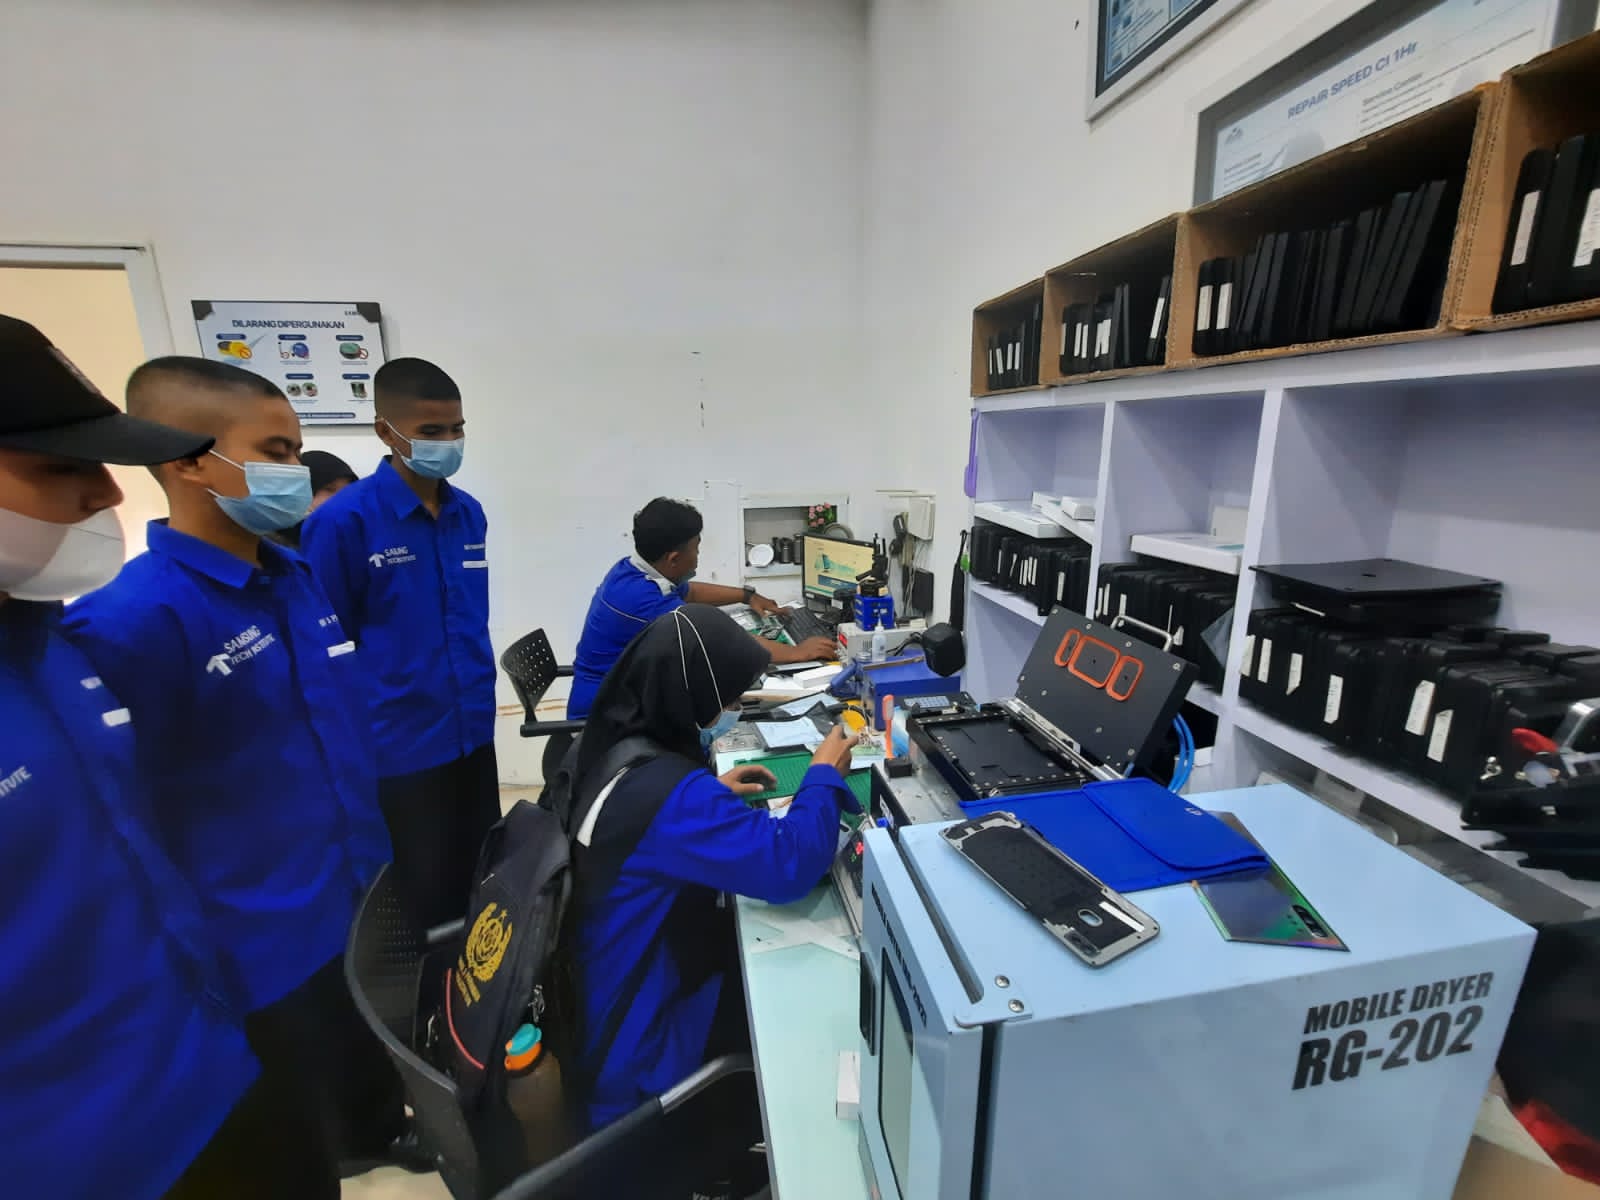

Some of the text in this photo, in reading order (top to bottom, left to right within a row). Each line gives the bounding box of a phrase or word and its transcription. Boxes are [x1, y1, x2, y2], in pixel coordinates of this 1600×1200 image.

[1287, 87, 1330, 120] REPAIR
[1330, 64, 1374, 97] SPEED
[231, 319, 345, 329] DILARANG DIPERGUNAKAN
[1304, 971, 1494, 1035] MOBILE DRYER
[1291, 1004, 1484, 1091] RG-202
